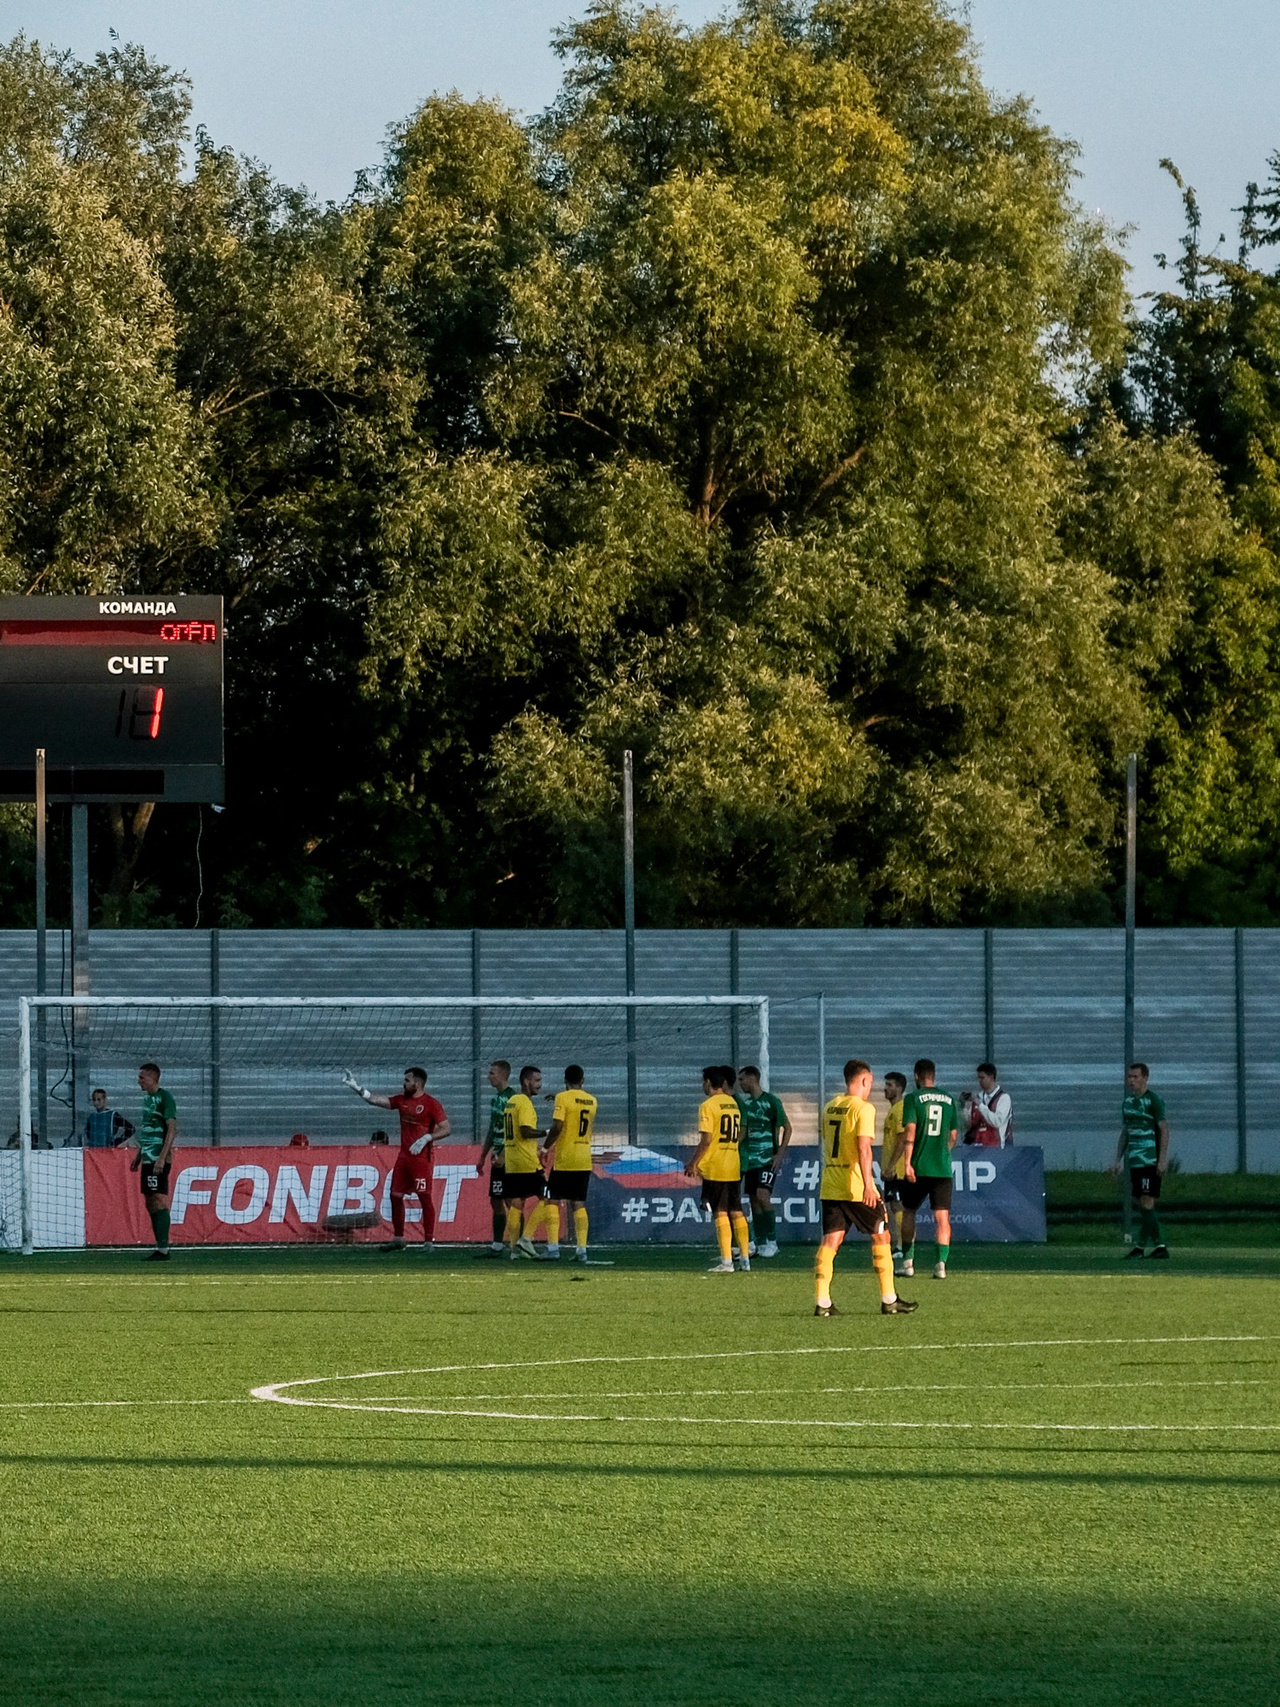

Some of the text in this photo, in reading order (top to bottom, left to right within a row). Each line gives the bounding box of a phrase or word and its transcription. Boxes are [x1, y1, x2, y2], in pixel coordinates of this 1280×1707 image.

[99, 602, 177, 616] КОМАНДА
[107, 656, 169, 674] СЧЕТ
[150, 687, 164, 739] 1
[578, 1109, 589, 1137] 6
[719, 1114, 739, 1143] 96
[928, 1104, 942, 1136] 9
[829, 1120, 841, 1158] 7
[416, 1178, 426, 1190] 75
[761, 1171, 773, 1183] 97
